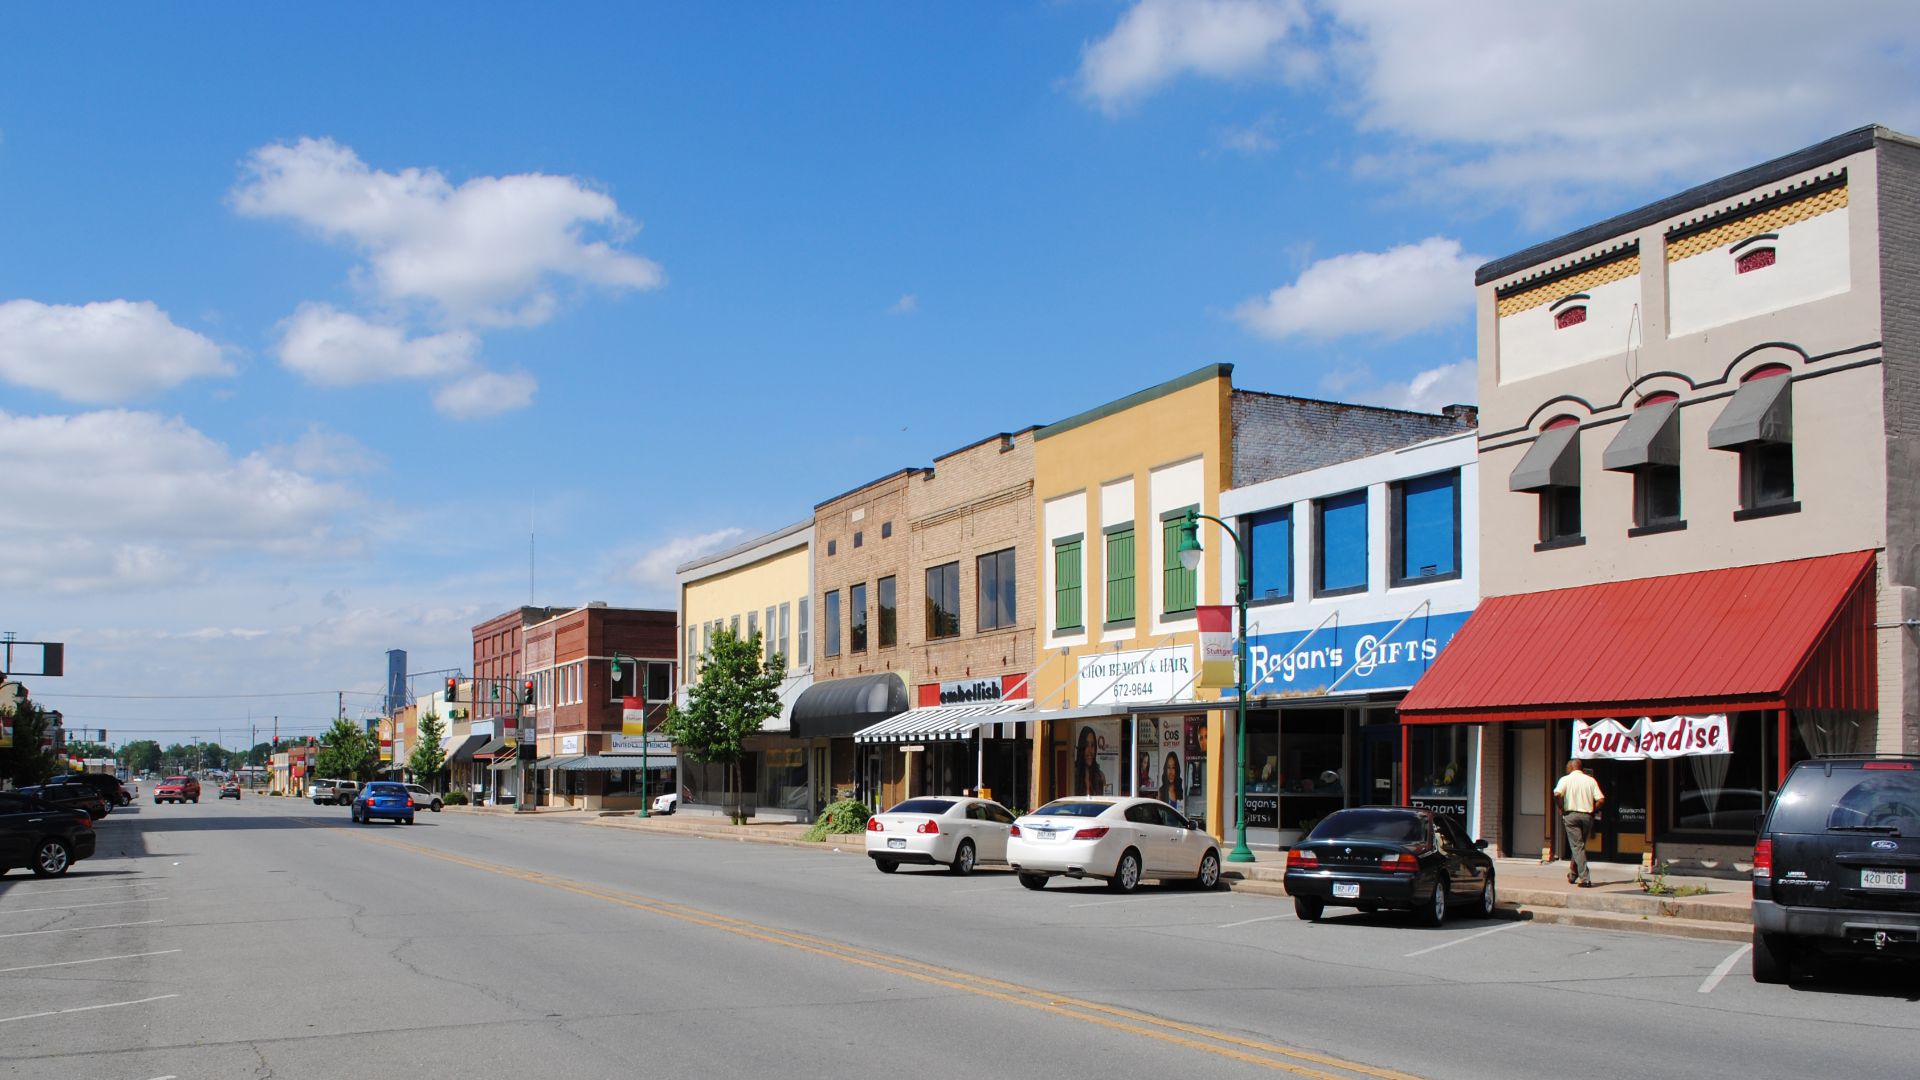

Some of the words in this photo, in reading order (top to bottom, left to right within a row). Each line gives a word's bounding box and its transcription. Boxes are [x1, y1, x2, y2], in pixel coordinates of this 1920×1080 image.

[1081, 664, 1106, 679] CHOI
[1109, 660, 1147, 677] BEAUTY
[1149, 661, 1156, 673] &
[1160, 657, 1189, 674] HAIR
[1249, 645, 1343, 684] Ragan's
[1354, 634, 1437, 677] GIFTS
[940, 681, 1001, 704] embellish
[1113, 682, 1153, 697] 672-9644
[1245, 797, 1277, 811] agan's
